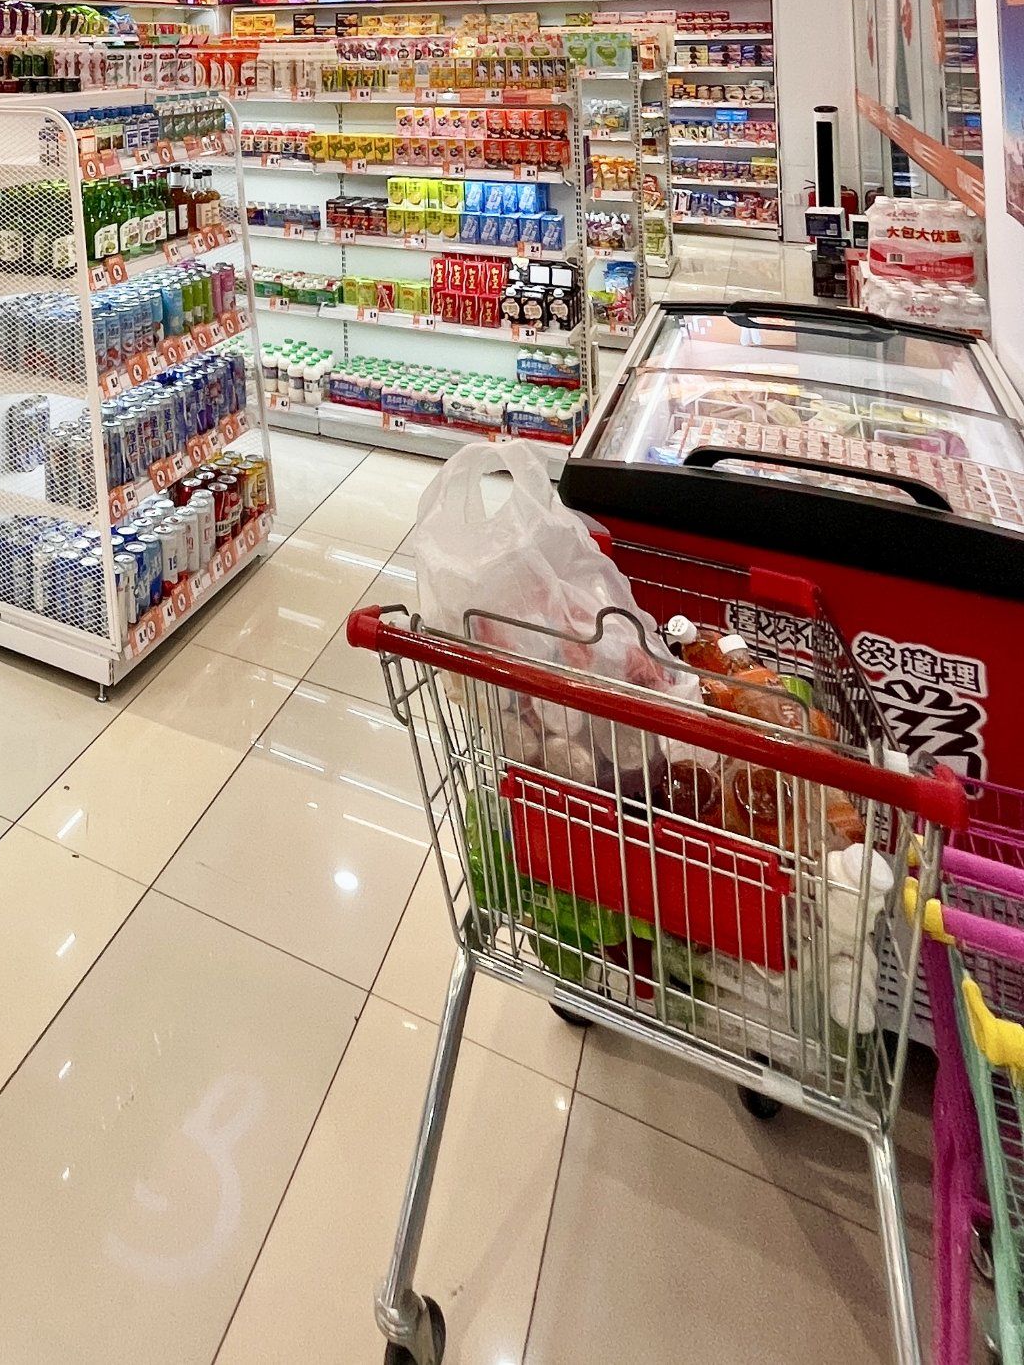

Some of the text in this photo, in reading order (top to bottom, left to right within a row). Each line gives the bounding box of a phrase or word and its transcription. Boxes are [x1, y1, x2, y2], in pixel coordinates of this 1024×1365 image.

[887, 225, 962, 244] 大包大优惠
[858, 636, 979, 692] 没道理
